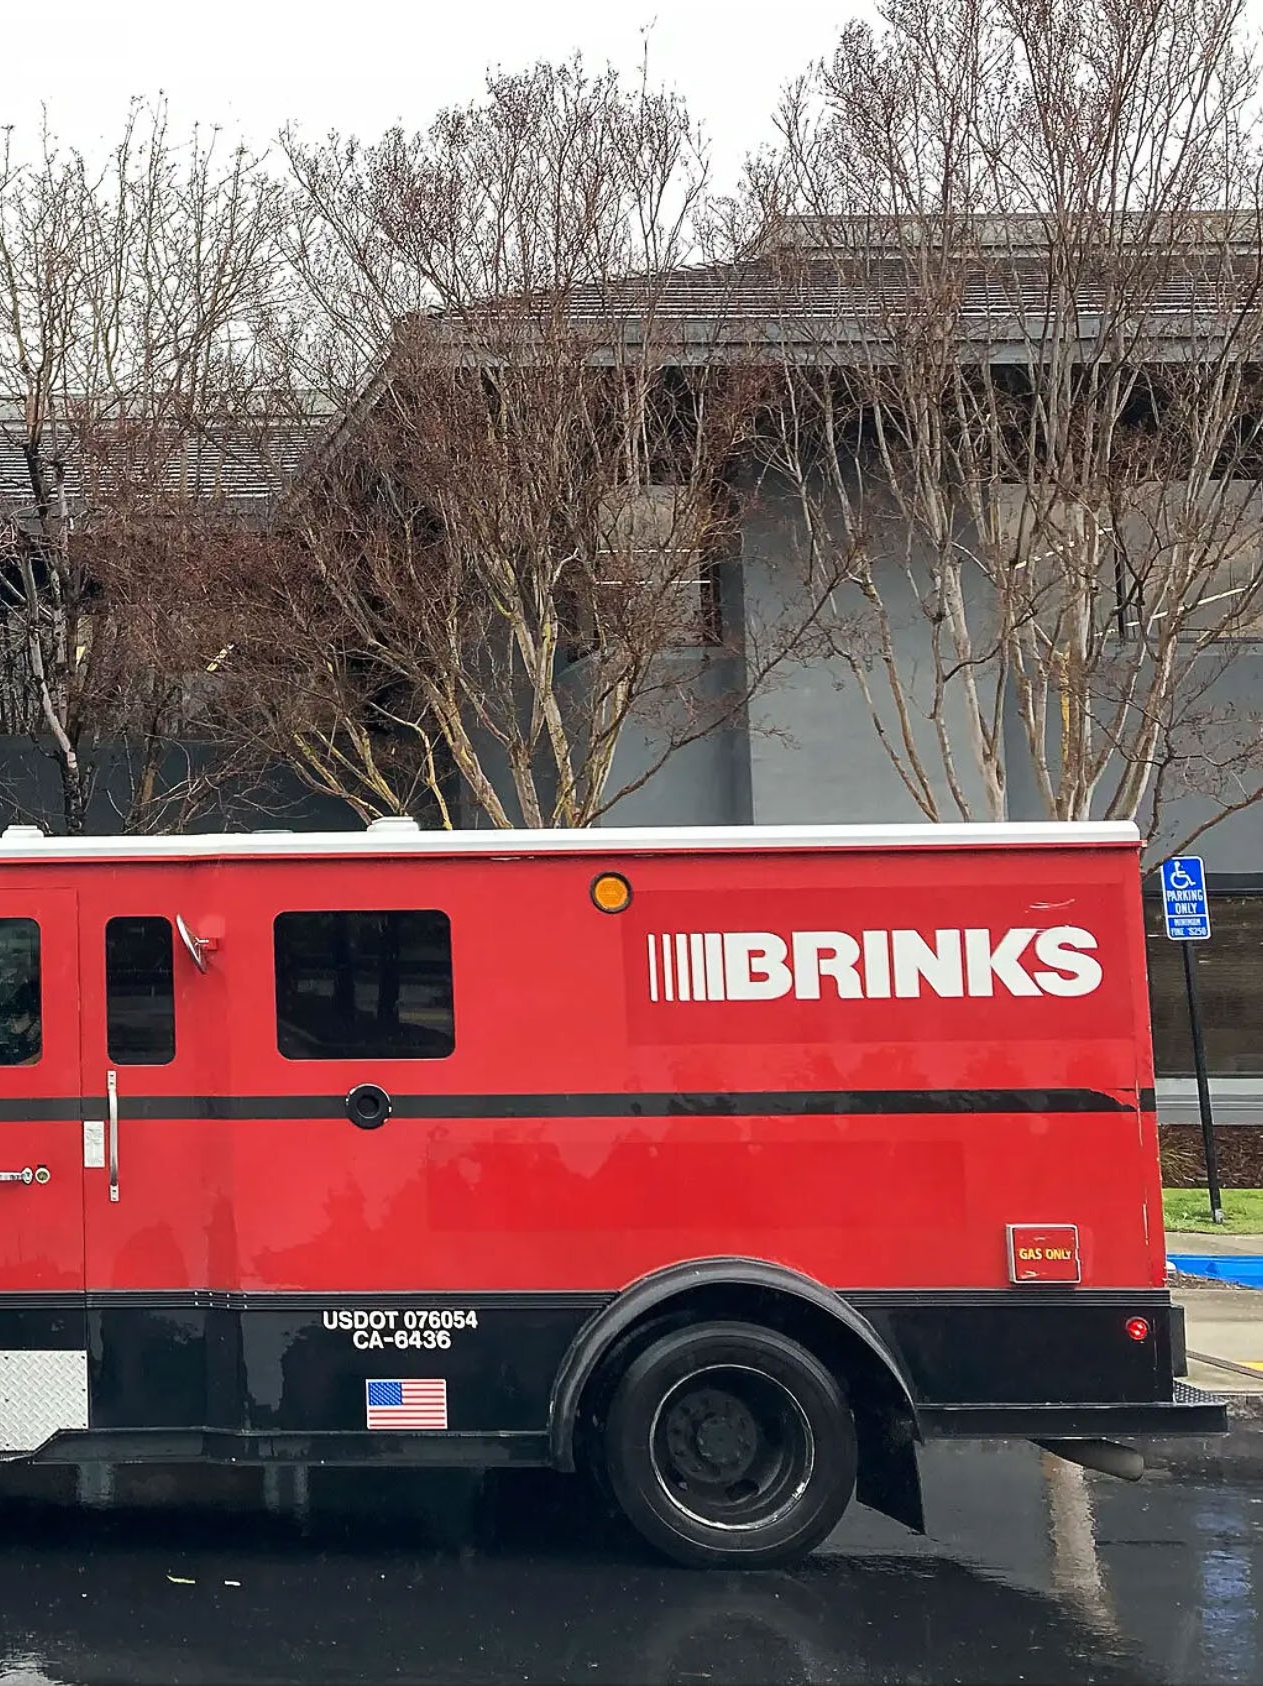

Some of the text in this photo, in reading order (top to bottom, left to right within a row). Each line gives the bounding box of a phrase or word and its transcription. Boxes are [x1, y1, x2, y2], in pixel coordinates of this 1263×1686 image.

[1166, 889, 1204, 902] PARKING
[1175, 902, 1197, 914] ONLY
[722, 925, 1103, 1001] BRINKS
[1019, 1247, 1071, 1260] GAS ONLY
[323, 1310, 479, 1330] USDOT 076054
[352, 1330, 452, 1349] CA-6436
